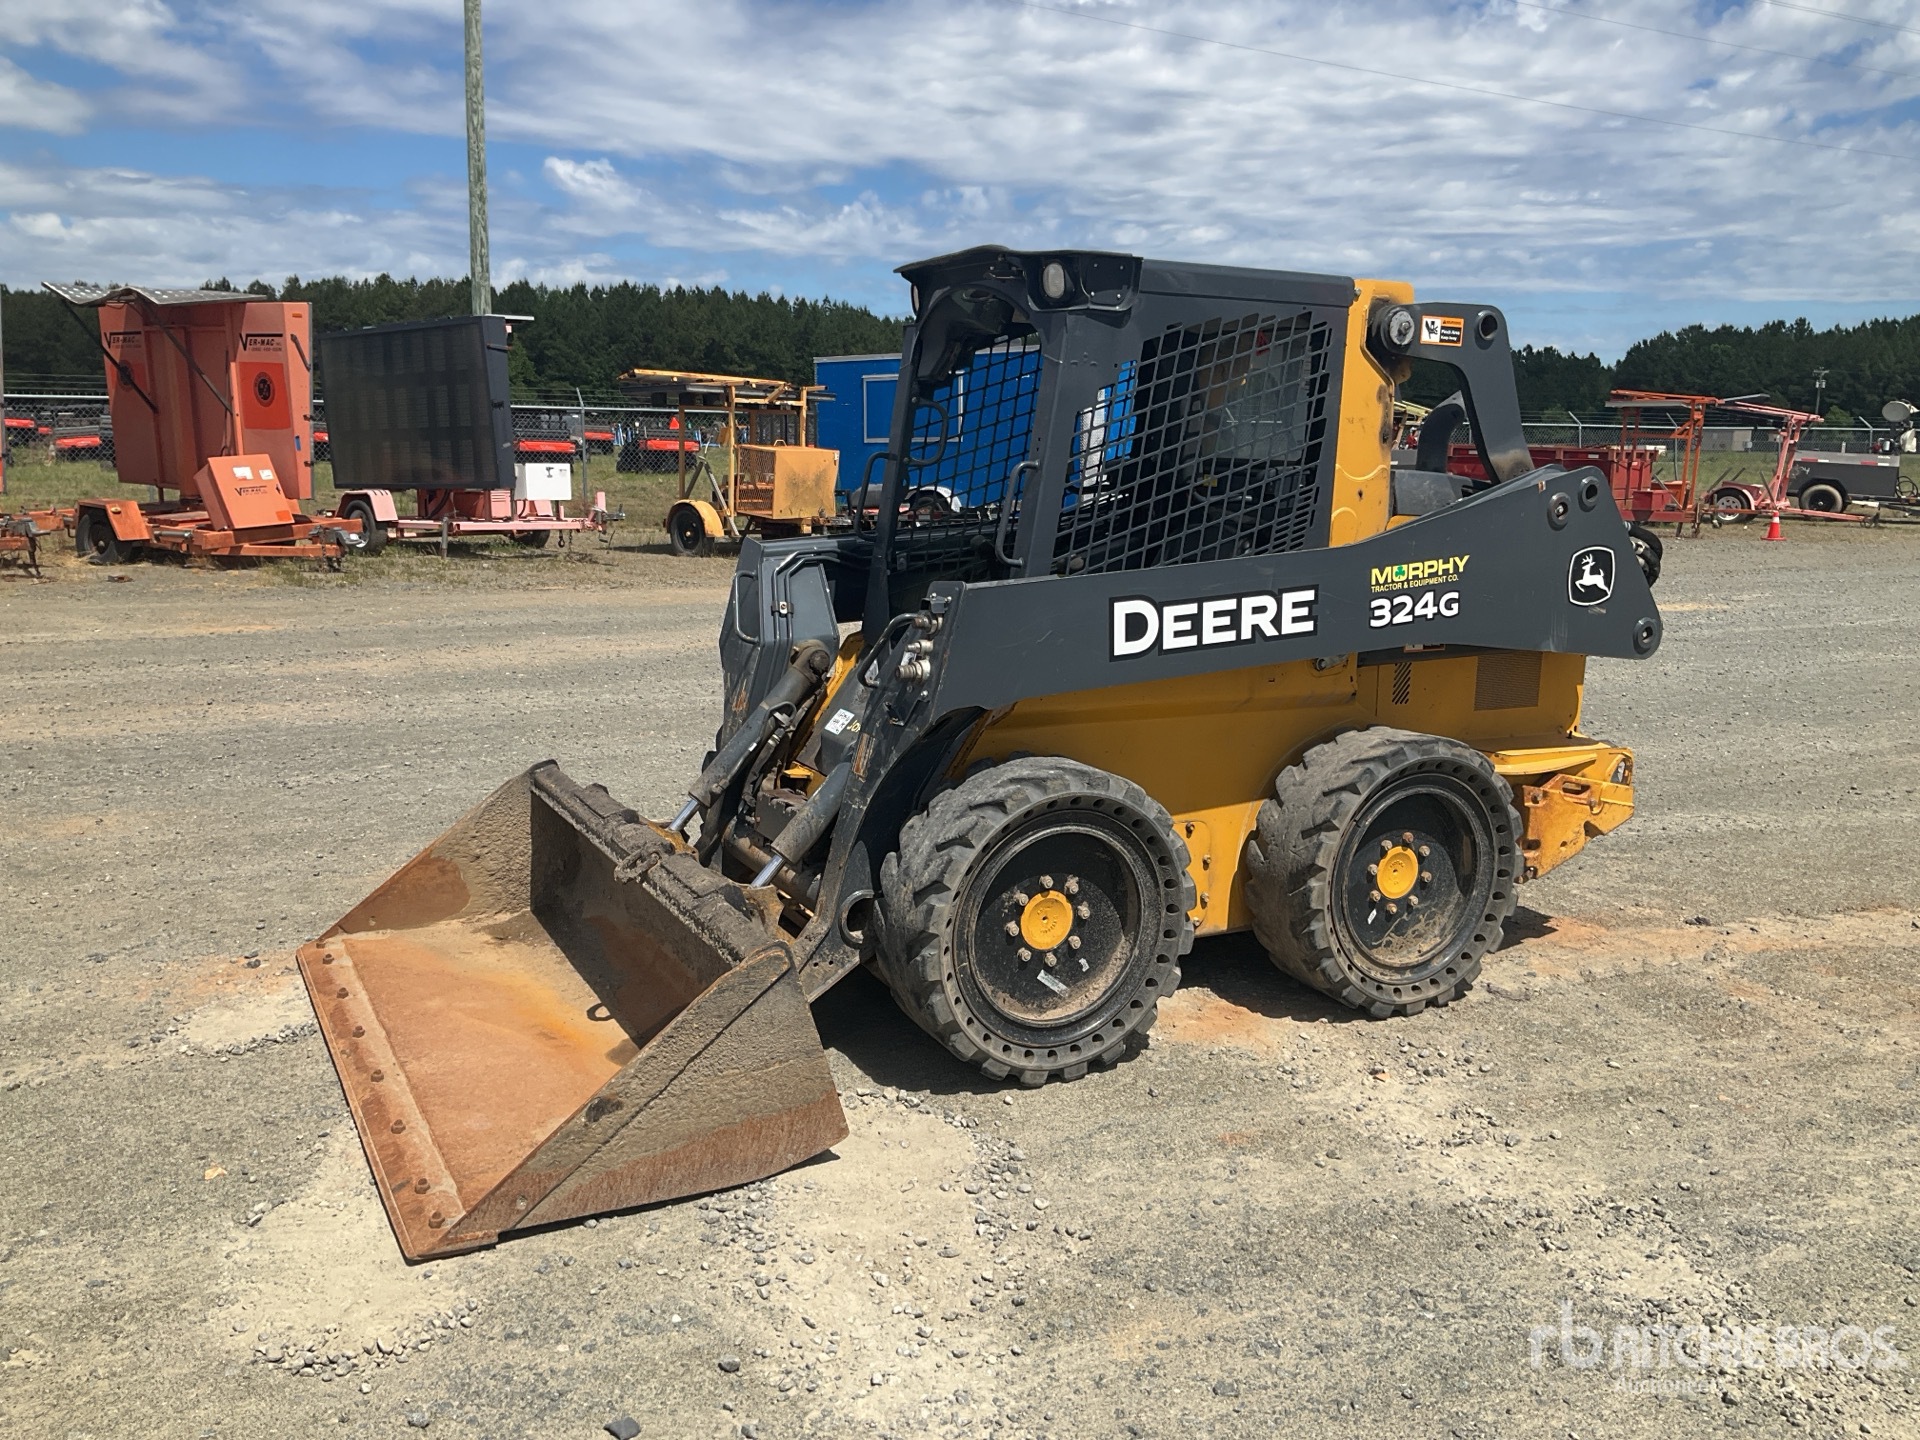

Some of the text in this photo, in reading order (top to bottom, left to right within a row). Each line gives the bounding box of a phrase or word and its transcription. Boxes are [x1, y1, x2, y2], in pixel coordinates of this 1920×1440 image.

[239, 333, 283, 351] VER-MAC
[1371, 555, 1470, 585] MURPHY
[1371, 574, 1459, 593] TRACTOR & EQUIPMENT CO.
[1113, 589, 1315, 657] DEERE
[1369, 590, 1460, 628] 324G
